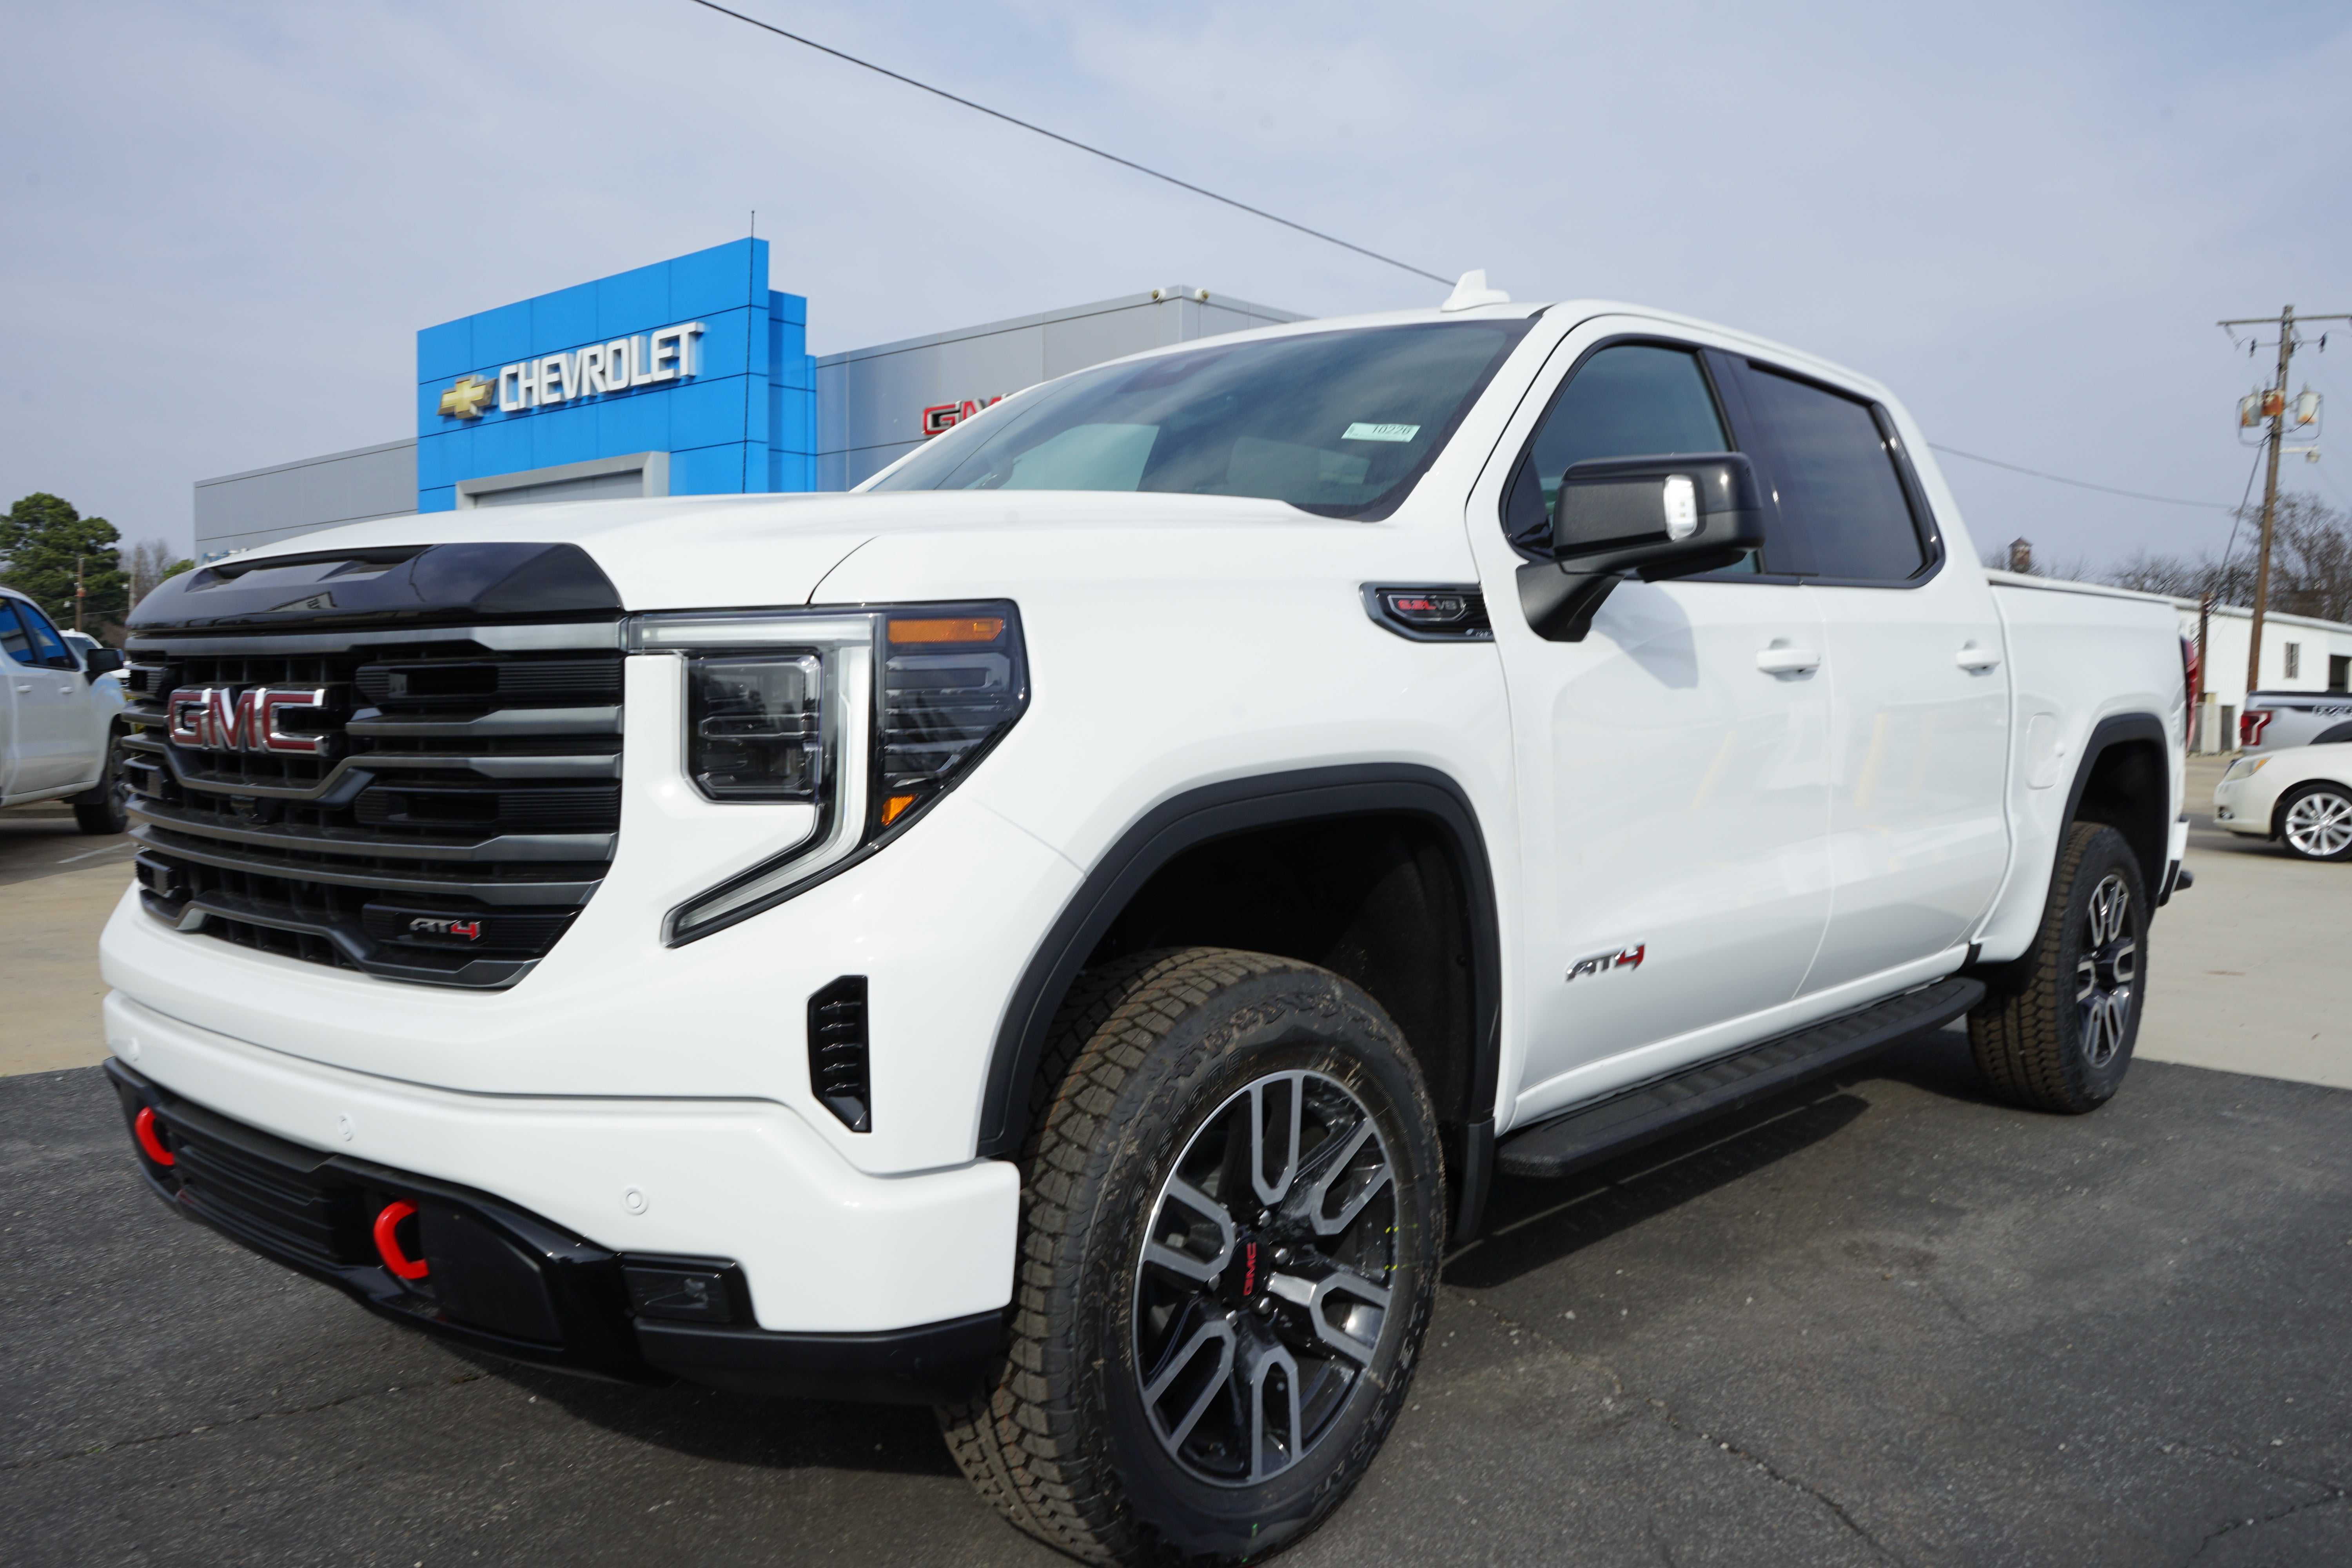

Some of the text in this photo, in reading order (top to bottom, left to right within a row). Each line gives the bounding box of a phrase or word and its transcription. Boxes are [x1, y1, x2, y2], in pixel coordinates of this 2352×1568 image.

[499, 321, 706, 412] CHEVROLET
[169, 688, 328, 757] GMC
[410, 918, 482, 941] AT4
[1566, 941, 1645, 981] AT4
[1243, 1241, 1256, 1296] GMC
